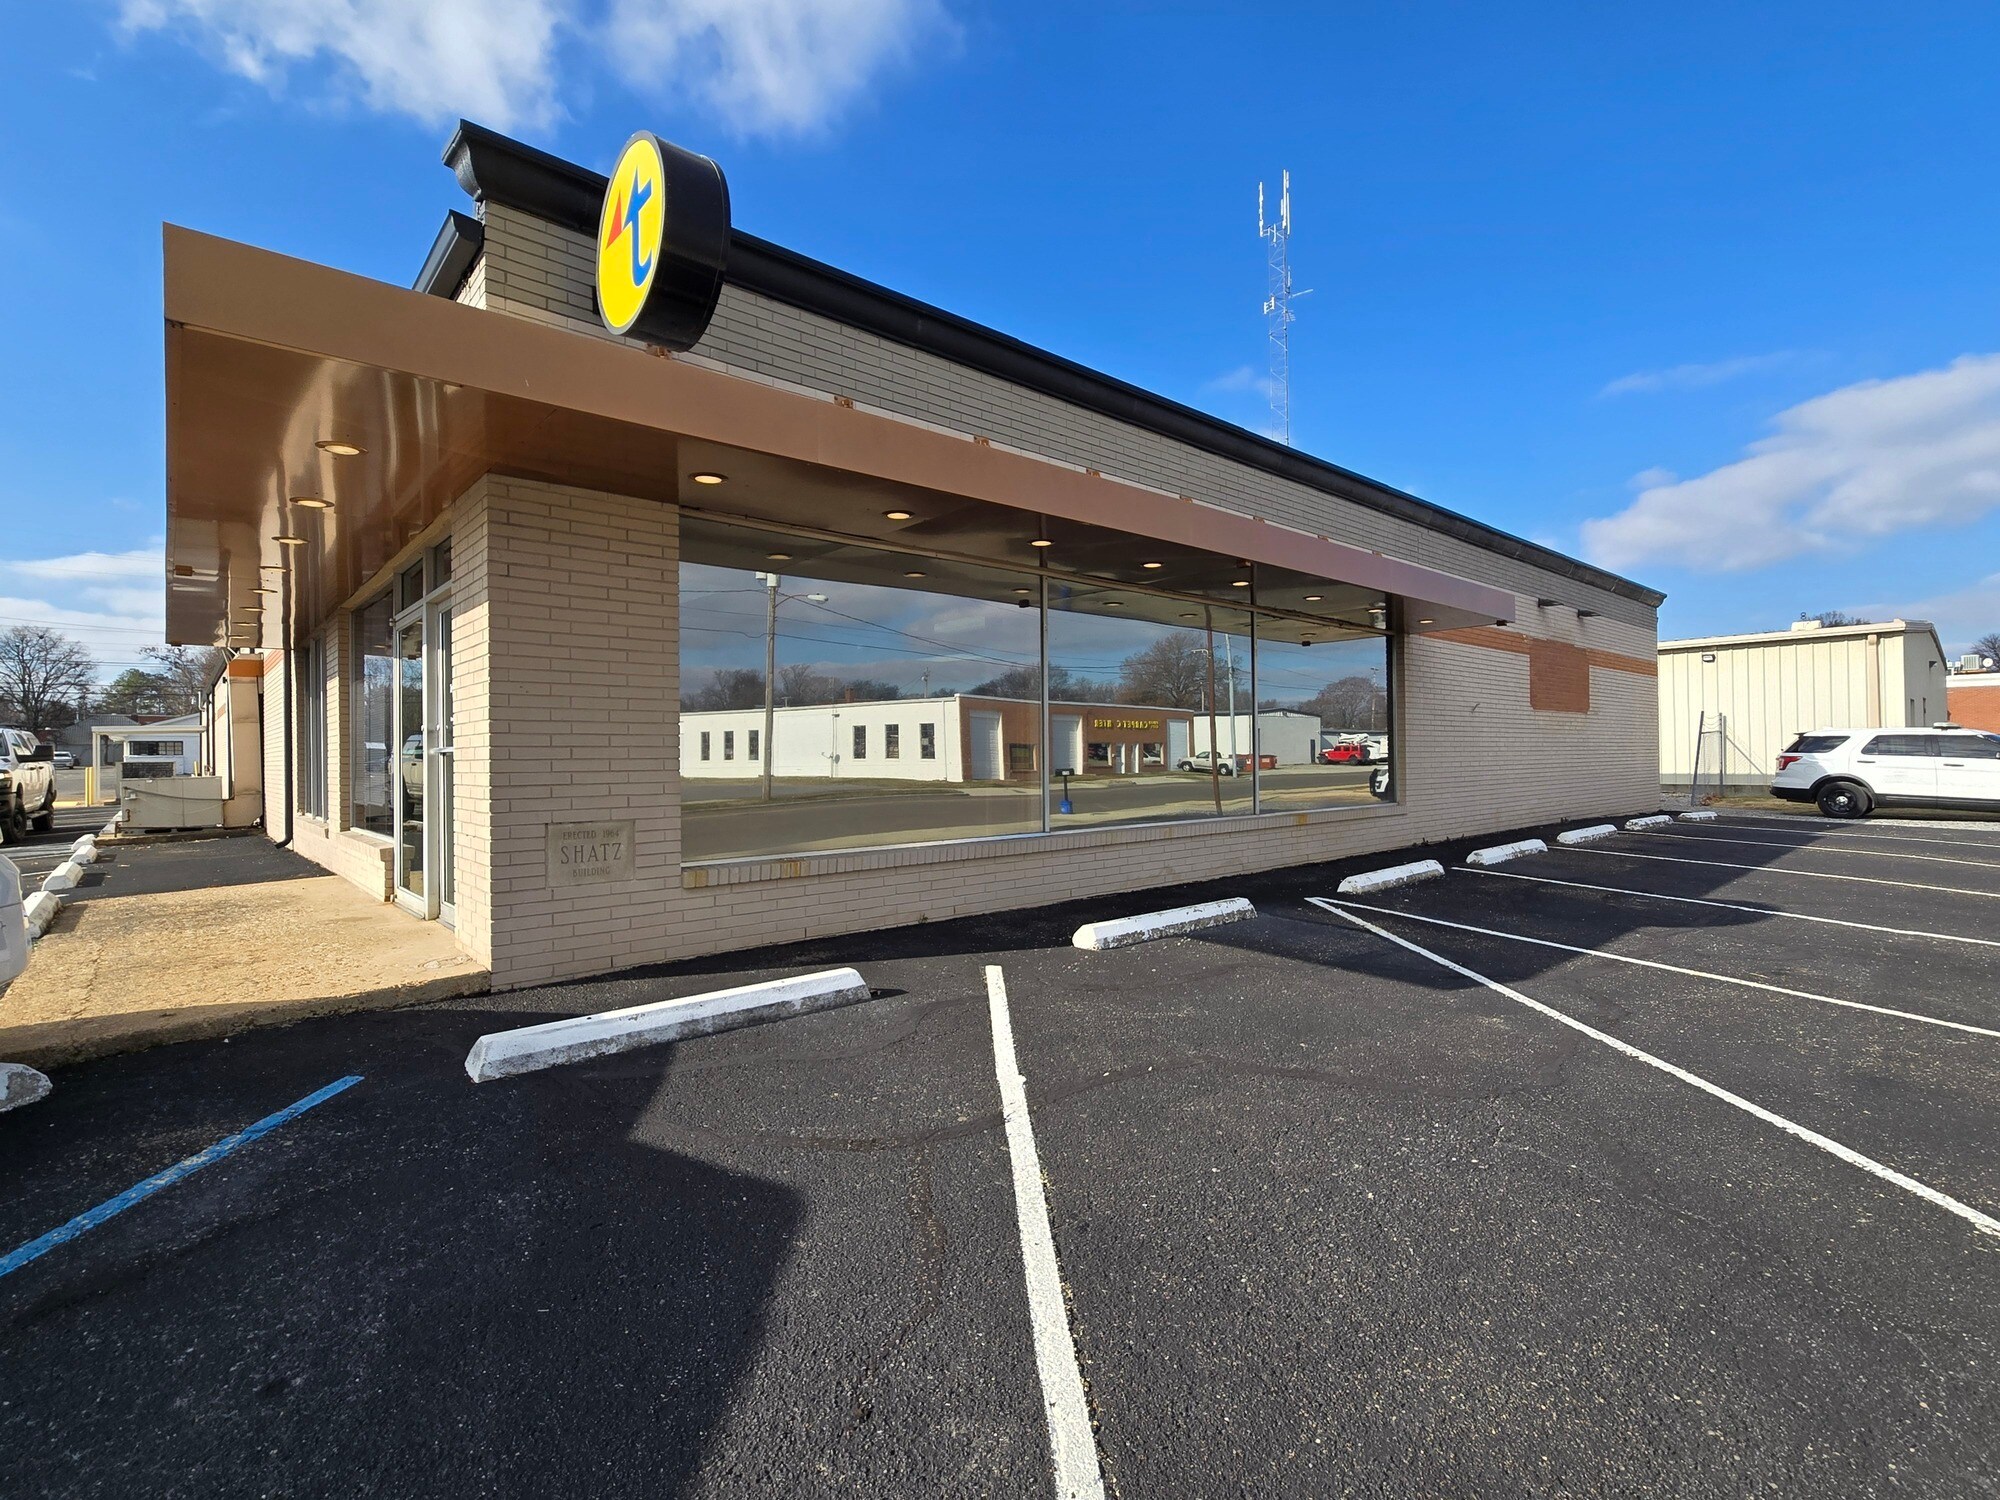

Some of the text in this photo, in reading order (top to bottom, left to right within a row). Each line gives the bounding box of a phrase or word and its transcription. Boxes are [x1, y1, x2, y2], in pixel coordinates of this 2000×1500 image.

[563, 830, 620, 840] ERECTED 1964
[560, 842, 622, 864] SHATZ
[572, 866, 611, 877] BUILDING
